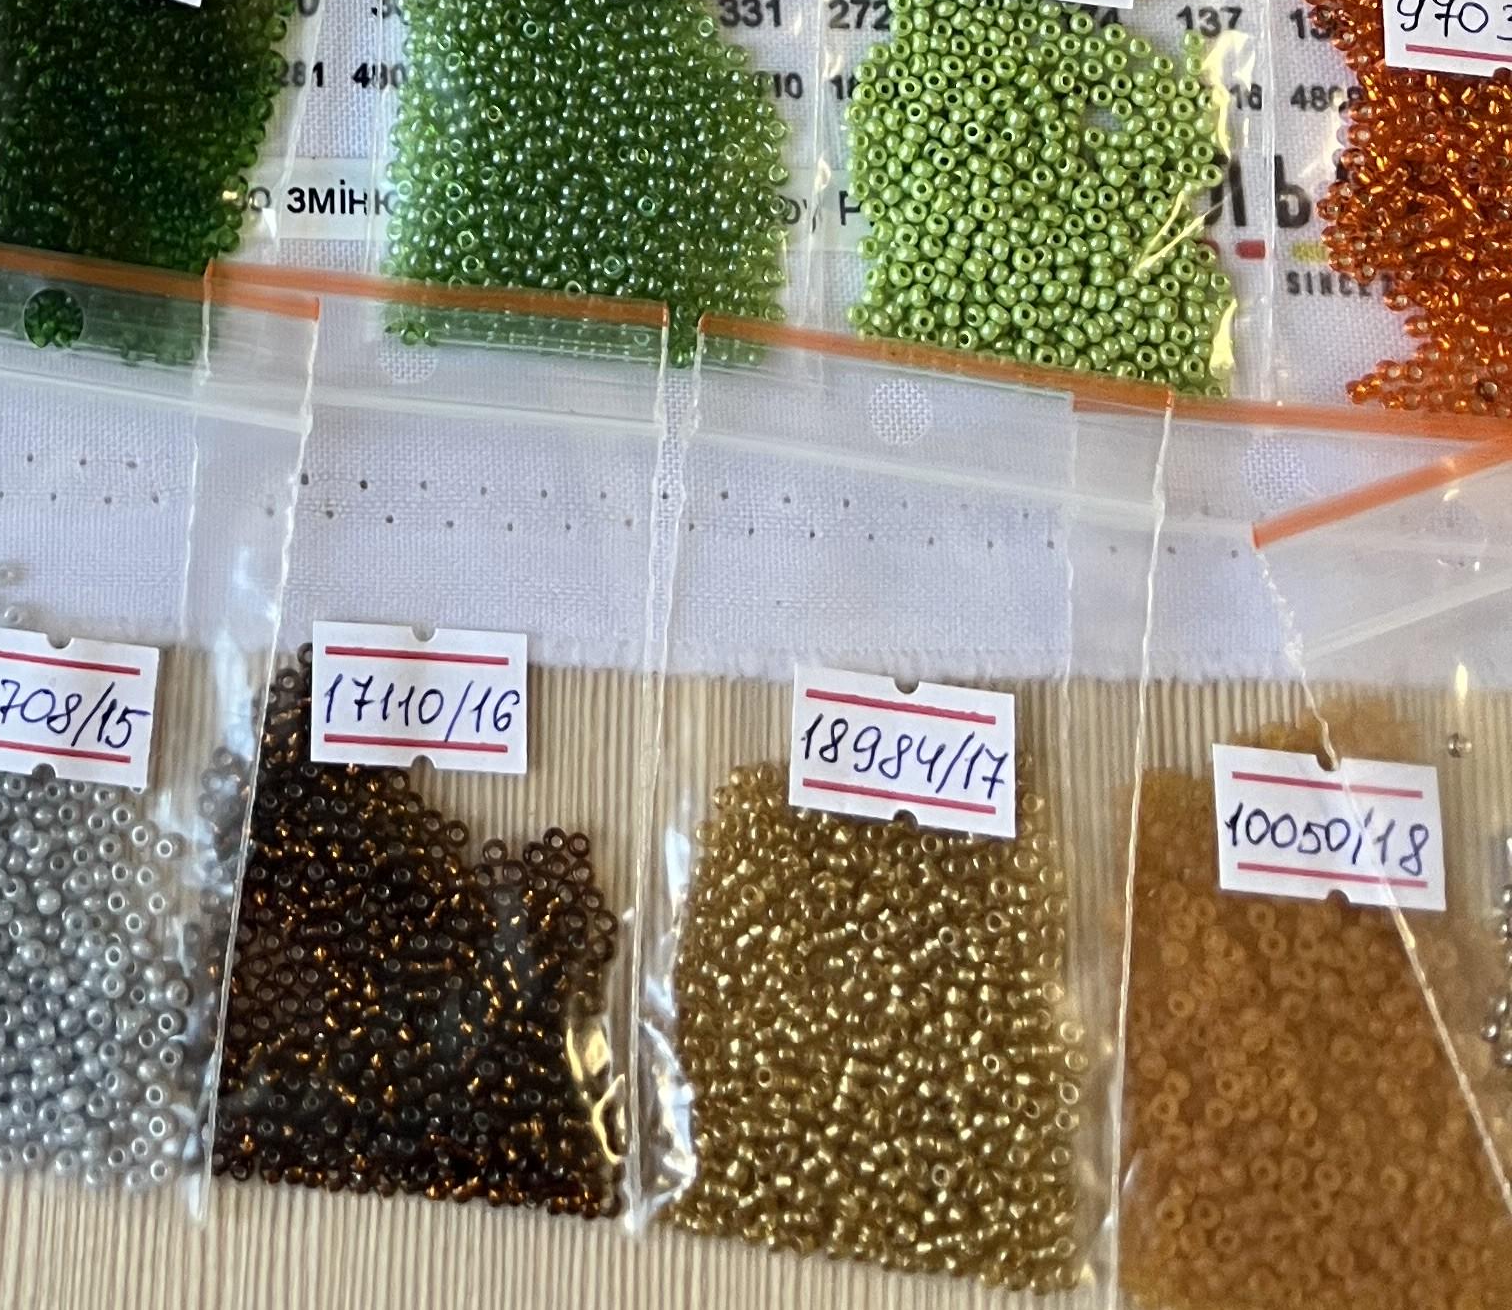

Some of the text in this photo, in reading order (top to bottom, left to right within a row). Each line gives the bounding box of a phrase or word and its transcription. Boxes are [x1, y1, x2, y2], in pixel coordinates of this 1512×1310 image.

[1176, 5, 1243, 37] 137
[322, 675, 521, 741] 17110/16
[800, 713, 1010, 800] 18984/17
[1224, 800, 1430, 875] 10050/18
